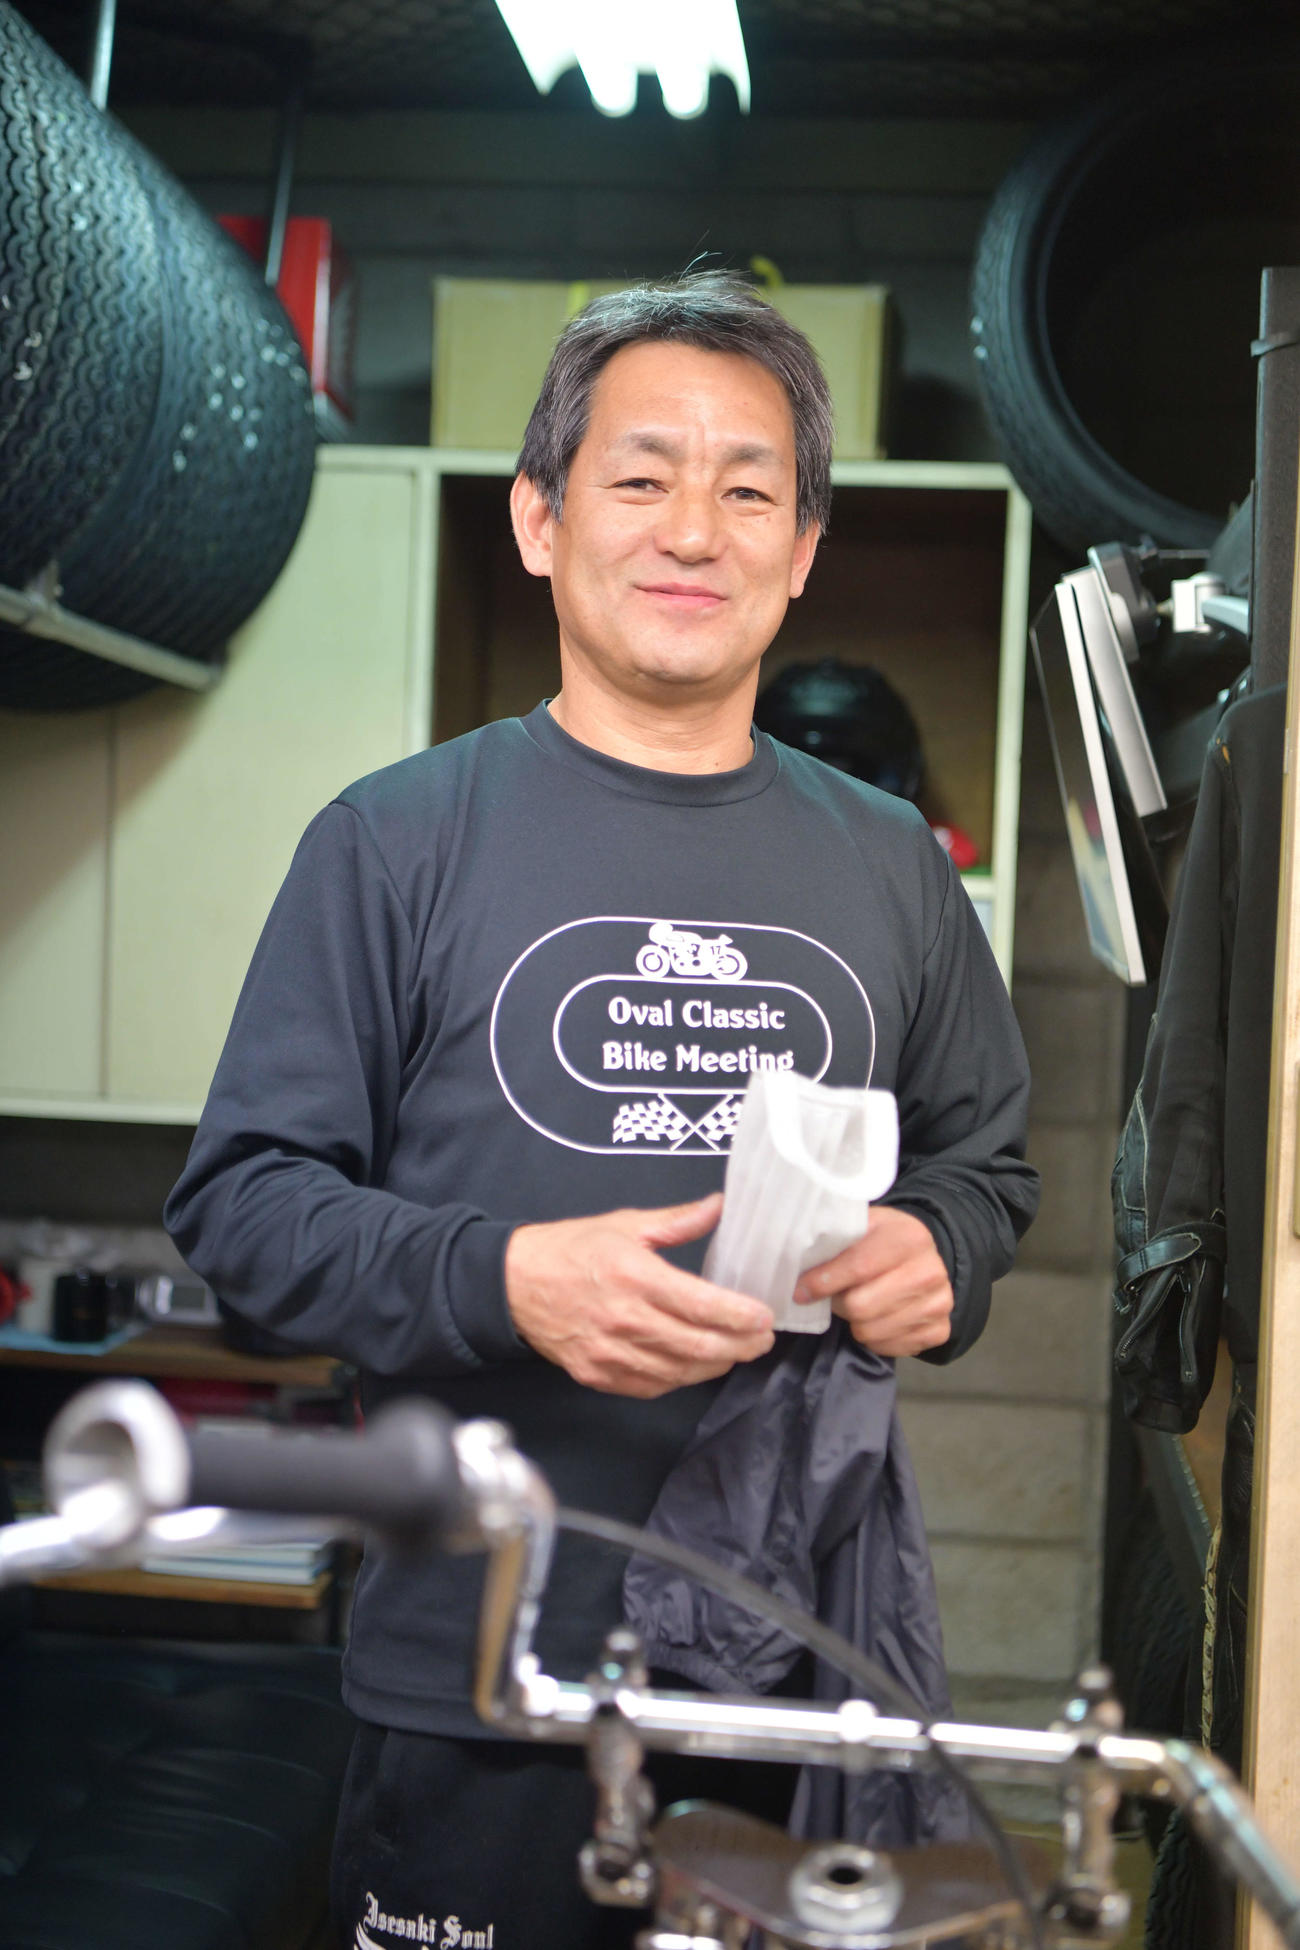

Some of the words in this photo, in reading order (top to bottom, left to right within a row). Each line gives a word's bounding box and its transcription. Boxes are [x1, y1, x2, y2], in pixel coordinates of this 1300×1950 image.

[608, 996, 673, 1028] Oval
[682, 1000, 786, 1031] Classic
[602, 1041, 667, 1072] Bike
[676, 1044, 795, 1074] Meeting
[440, 1915, 495, 1950] Soul
